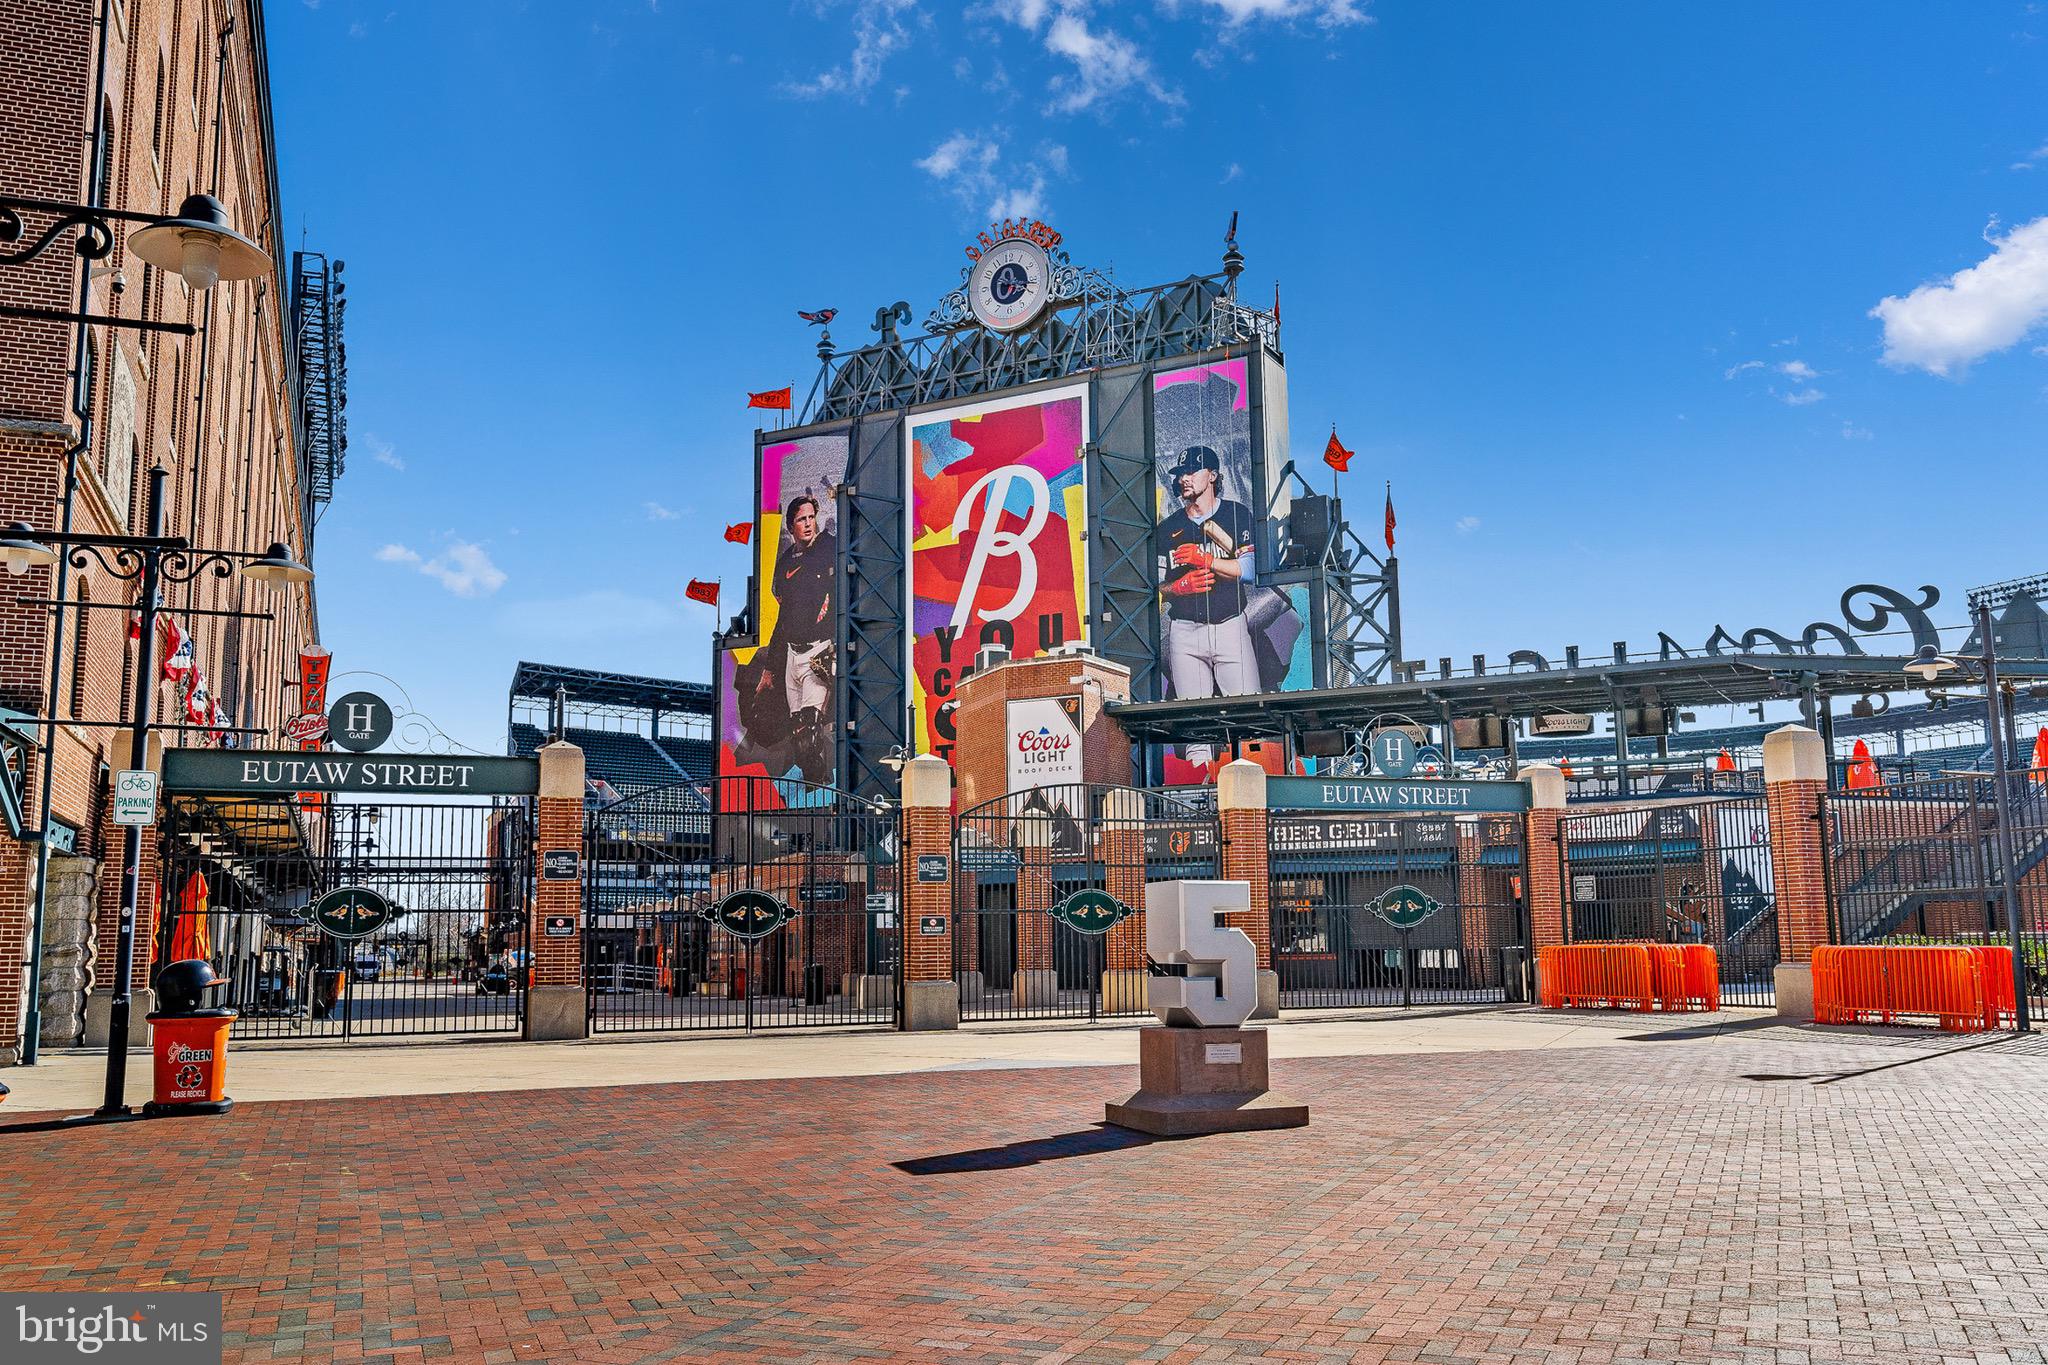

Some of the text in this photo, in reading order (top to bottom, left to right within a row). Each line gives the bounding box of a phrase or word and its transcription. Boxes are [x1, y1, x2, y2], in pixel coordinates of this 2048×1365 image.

[950, 464, 1050, 640] B
[934, 613, 1063, 663] YOU
[305, 660, 324, 711] TEAM
[288, 714, 329, 736] Oriole
[345, 703, 376, 732] H
[349, 732, 370, 740] GATE
[1018, 730, 1072, 753] Coors
[1024, 750, 1066, 764] LIGHT
[1385, 738, 1405, 761] H
[241, 760, 474, 787] EUTAW STREET
[118, 797, 153, 808] PARKING
[1323, 785, 1470, 806] EUTAW STREET
[545, 858, 557, 867] NO
[919, 862, 929, 871] NO
[1146, 880, 1258, 1028] 5
[178, 1049, 212, 1063] GREEN
[170, 1089, 206, 1098] PLEASE RECYCLE
